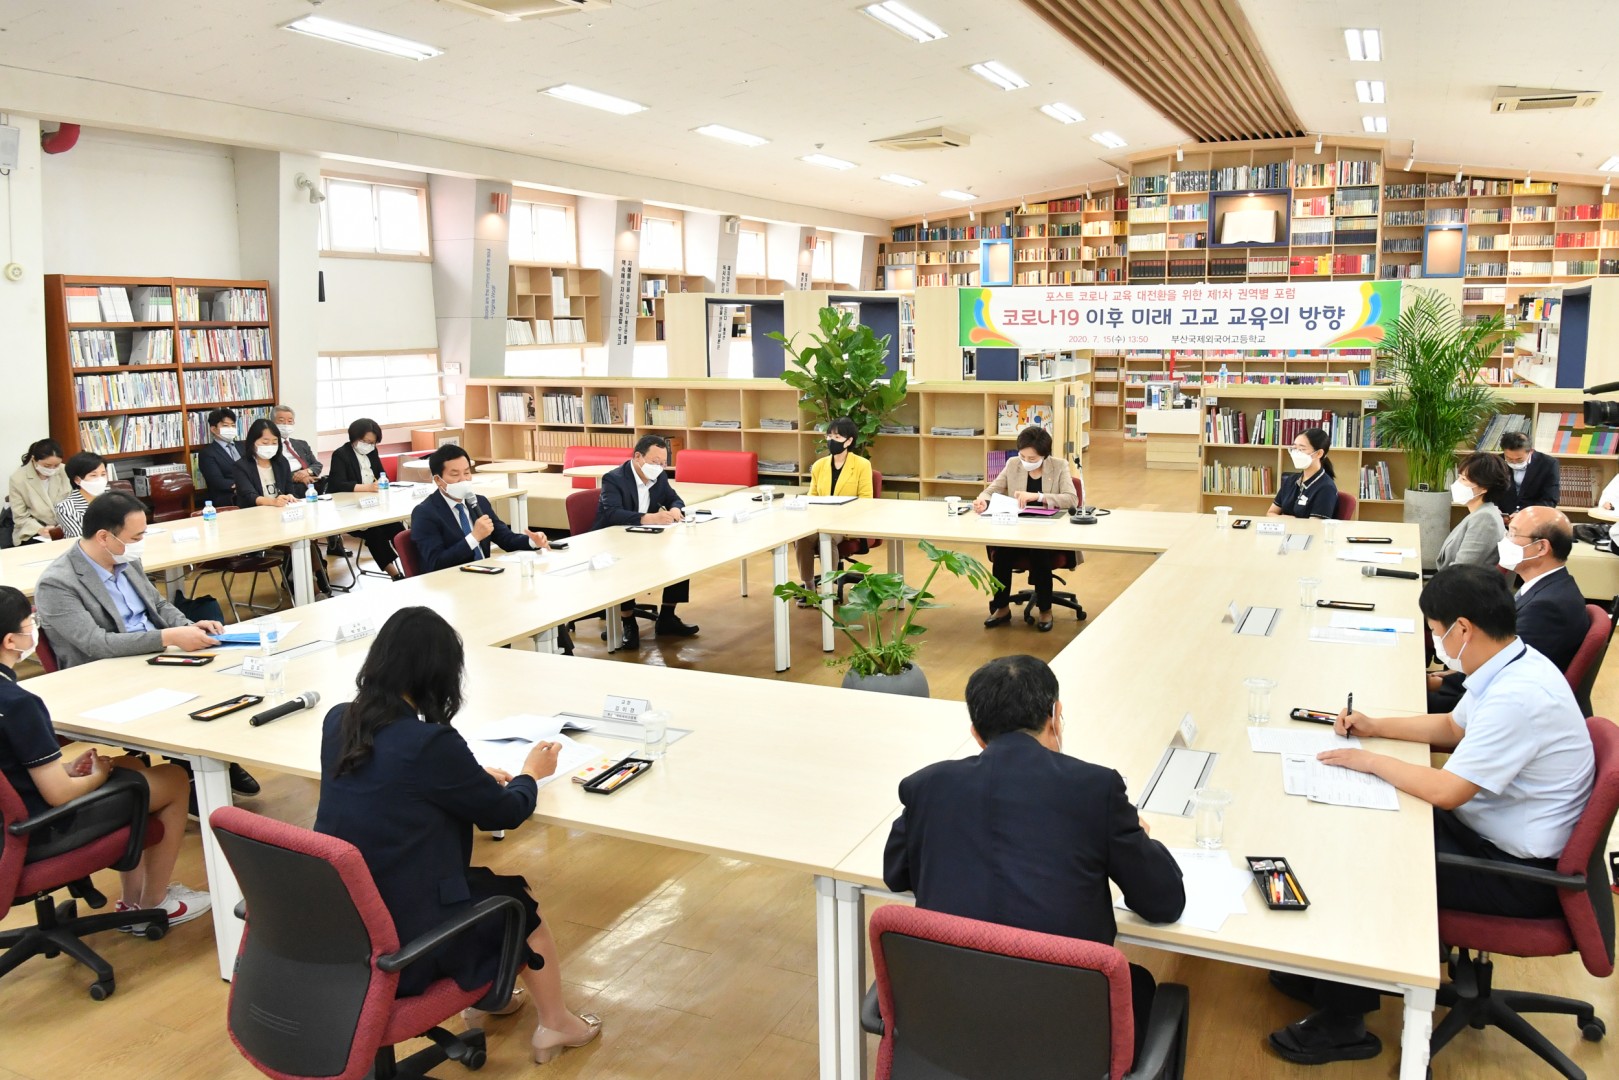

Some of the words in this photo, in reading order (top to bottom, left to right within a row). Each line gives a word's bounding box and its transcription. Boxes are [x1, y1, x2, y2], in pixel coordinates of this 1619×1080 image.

[1046, 291, 1074, 301] 포스트
[1079, 290, 1108, 301] 코로나
[1113, 289, 1132, 301] 교육
[1137, 289, 1177, 301] 대전환을
[1181, 288, 1202, 300] 위한
[1207, 287, 1232, 300] 제1차
[1237, 287, 1269, 300] 권역별
[1274, 286, 1296, 299] 포럼
[1002, 309, 1080, 326] 코로나19
[1086, 307, 1124, 329] 이후
[1131, 307, 1172, 326] 미래
[1179, 308, 1219, 326] 고교
[1228, 306, 1289, 331] 교육의
[1299, 305, 1346, 331] 방향
[1069, 335, 1089, 343] 2020.
[1093, 335, 1100, 343] 7.
[1103, 334, 1126, 344] 15(수)
[1128, 335, 1148, 343] 13:50
[1171, 333, 1266, 344] 부산국제외국어고등학교
